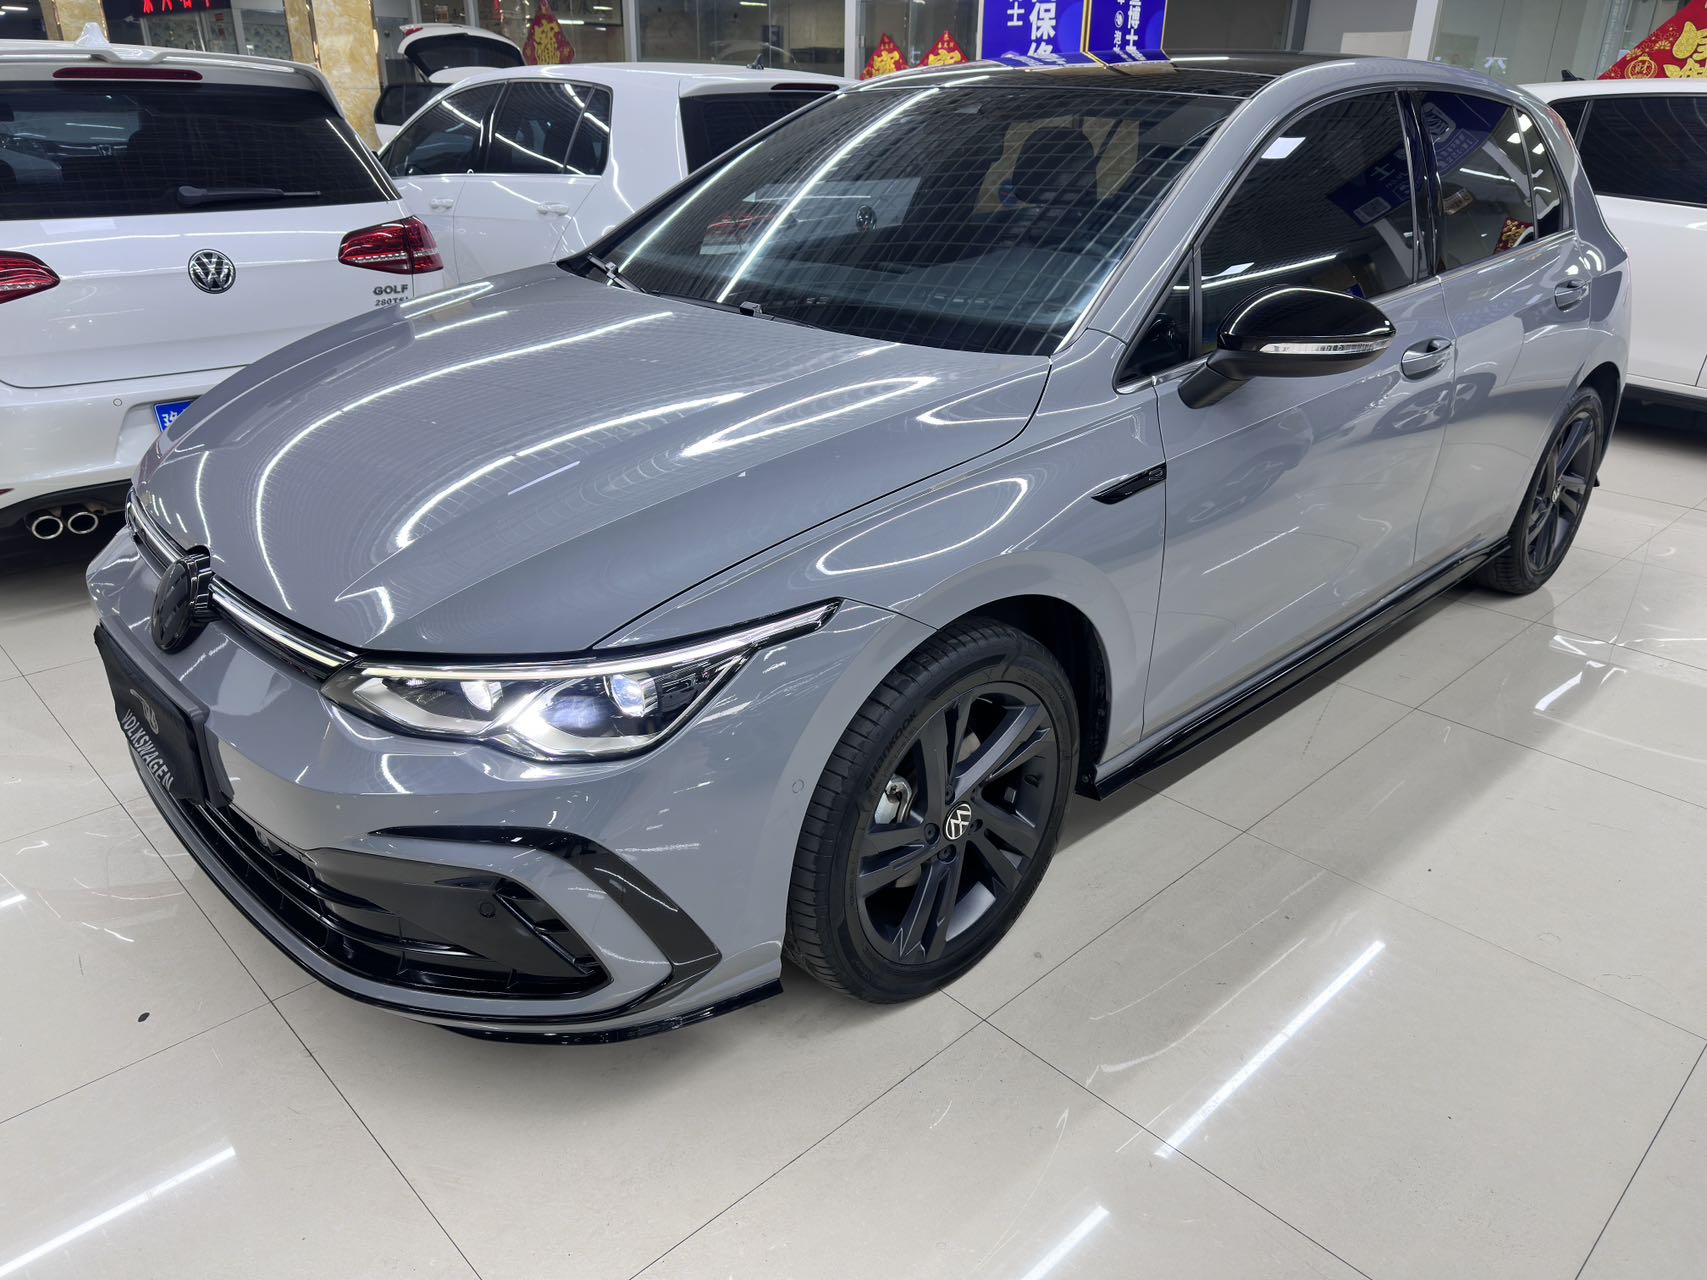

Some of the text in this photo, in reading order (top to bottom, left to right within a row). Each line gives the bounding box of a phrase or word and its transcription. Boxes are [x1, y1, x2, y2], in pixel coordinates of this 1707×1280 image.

[1007, 0, 1025, 26] 士
[1125, 0, 1141, 50] 博士
[188, 249, 236, 294] VW
[373, 284, 408, 296] GOLF
[121, 708, 174, 792] VOLKSWAGEN
